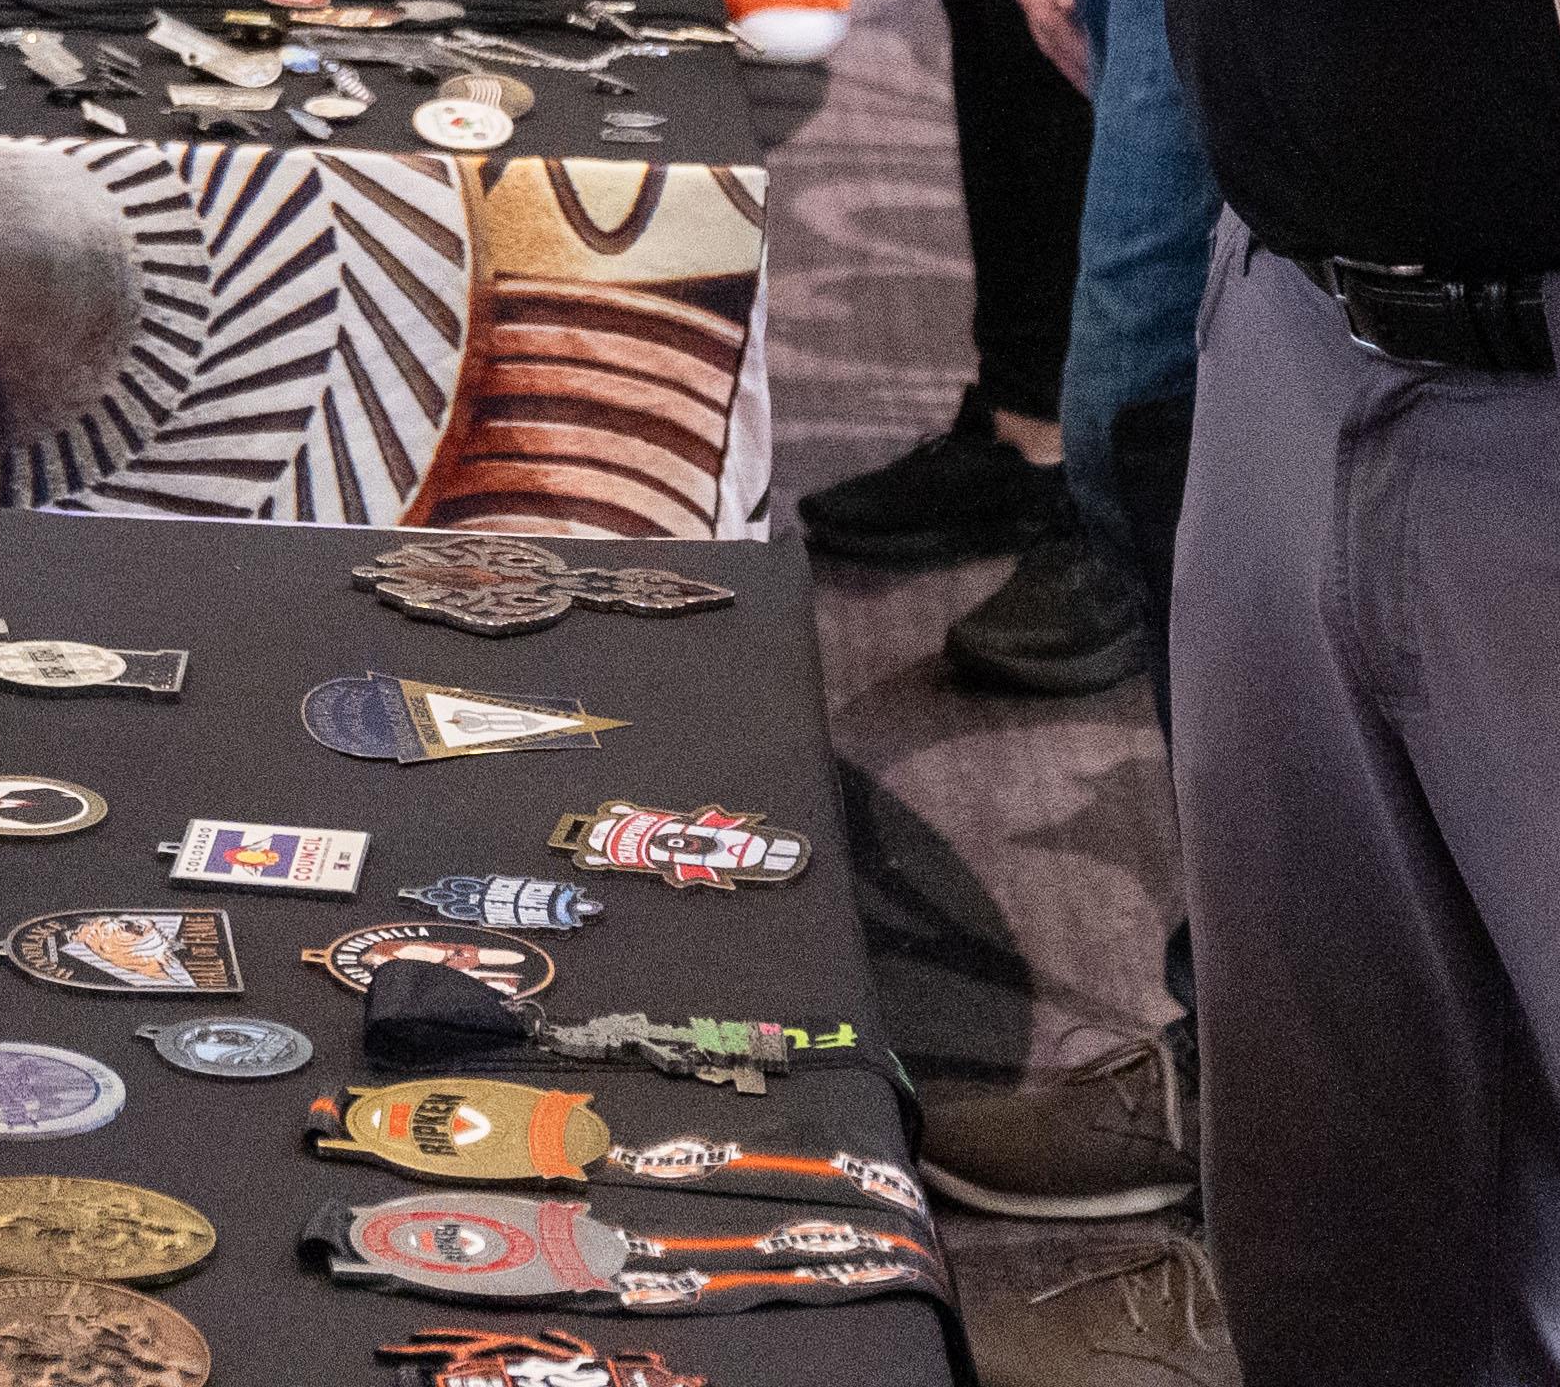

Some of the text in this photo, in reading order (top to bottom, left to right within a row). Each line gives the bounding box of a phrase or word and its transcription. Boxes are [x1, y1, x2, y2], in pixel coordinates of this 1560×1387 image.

[185, 827, 212, 873] COLORADO
[292, 836, 323, 882] COUNCIL
[618, 814, 659, 866] CHAMPIONS
[20, 919, 74, 981] WOODLAKE
[183, 915, 222, 945] FAME
[340, 927, 429, 953] VALHALLA
[185, 959, 231, 988] HALL
[411, 1091, 465, 1157] RIPKEN
[613, 1149, 729, 1169] RIPKEN
[434, 1223, 470, 1264] RIPKEN
